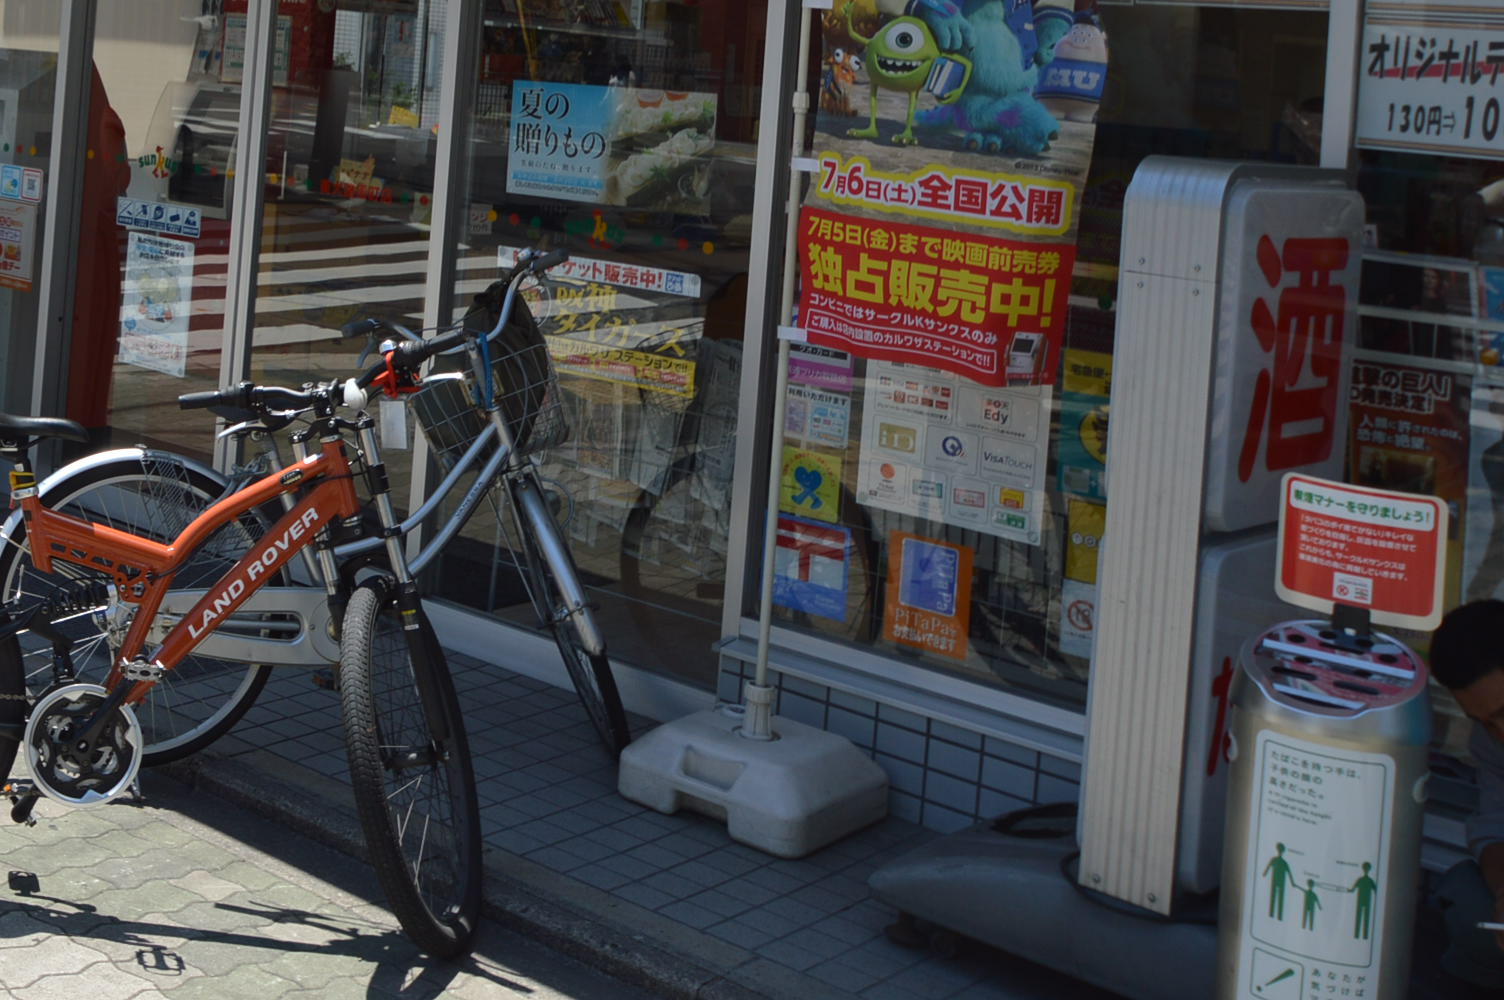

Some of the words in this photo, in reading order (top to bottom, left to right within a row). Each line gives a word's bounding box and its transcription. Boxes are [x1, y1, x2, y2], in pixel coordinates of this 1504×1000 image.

[519, 87, 570, 120] 夏の
[514, 122, 606, 160] 贈りもの
[821, 160, 1064, 226] 7月6日(土)全国公開
[807, 216, 1061, 275] 7月5日(金)まで映画前売券
[808, 242, 1057, 328] 独占販売中!
[809, 292, 998, 345] コンビニではサークルKサンクスのみ
[1237, 233, 1350, 484] 酒
[983, 408, 1009, 425] Edy
[187, 578, 246, 639] LAND
[246, 506, 320, 582] ROVER
